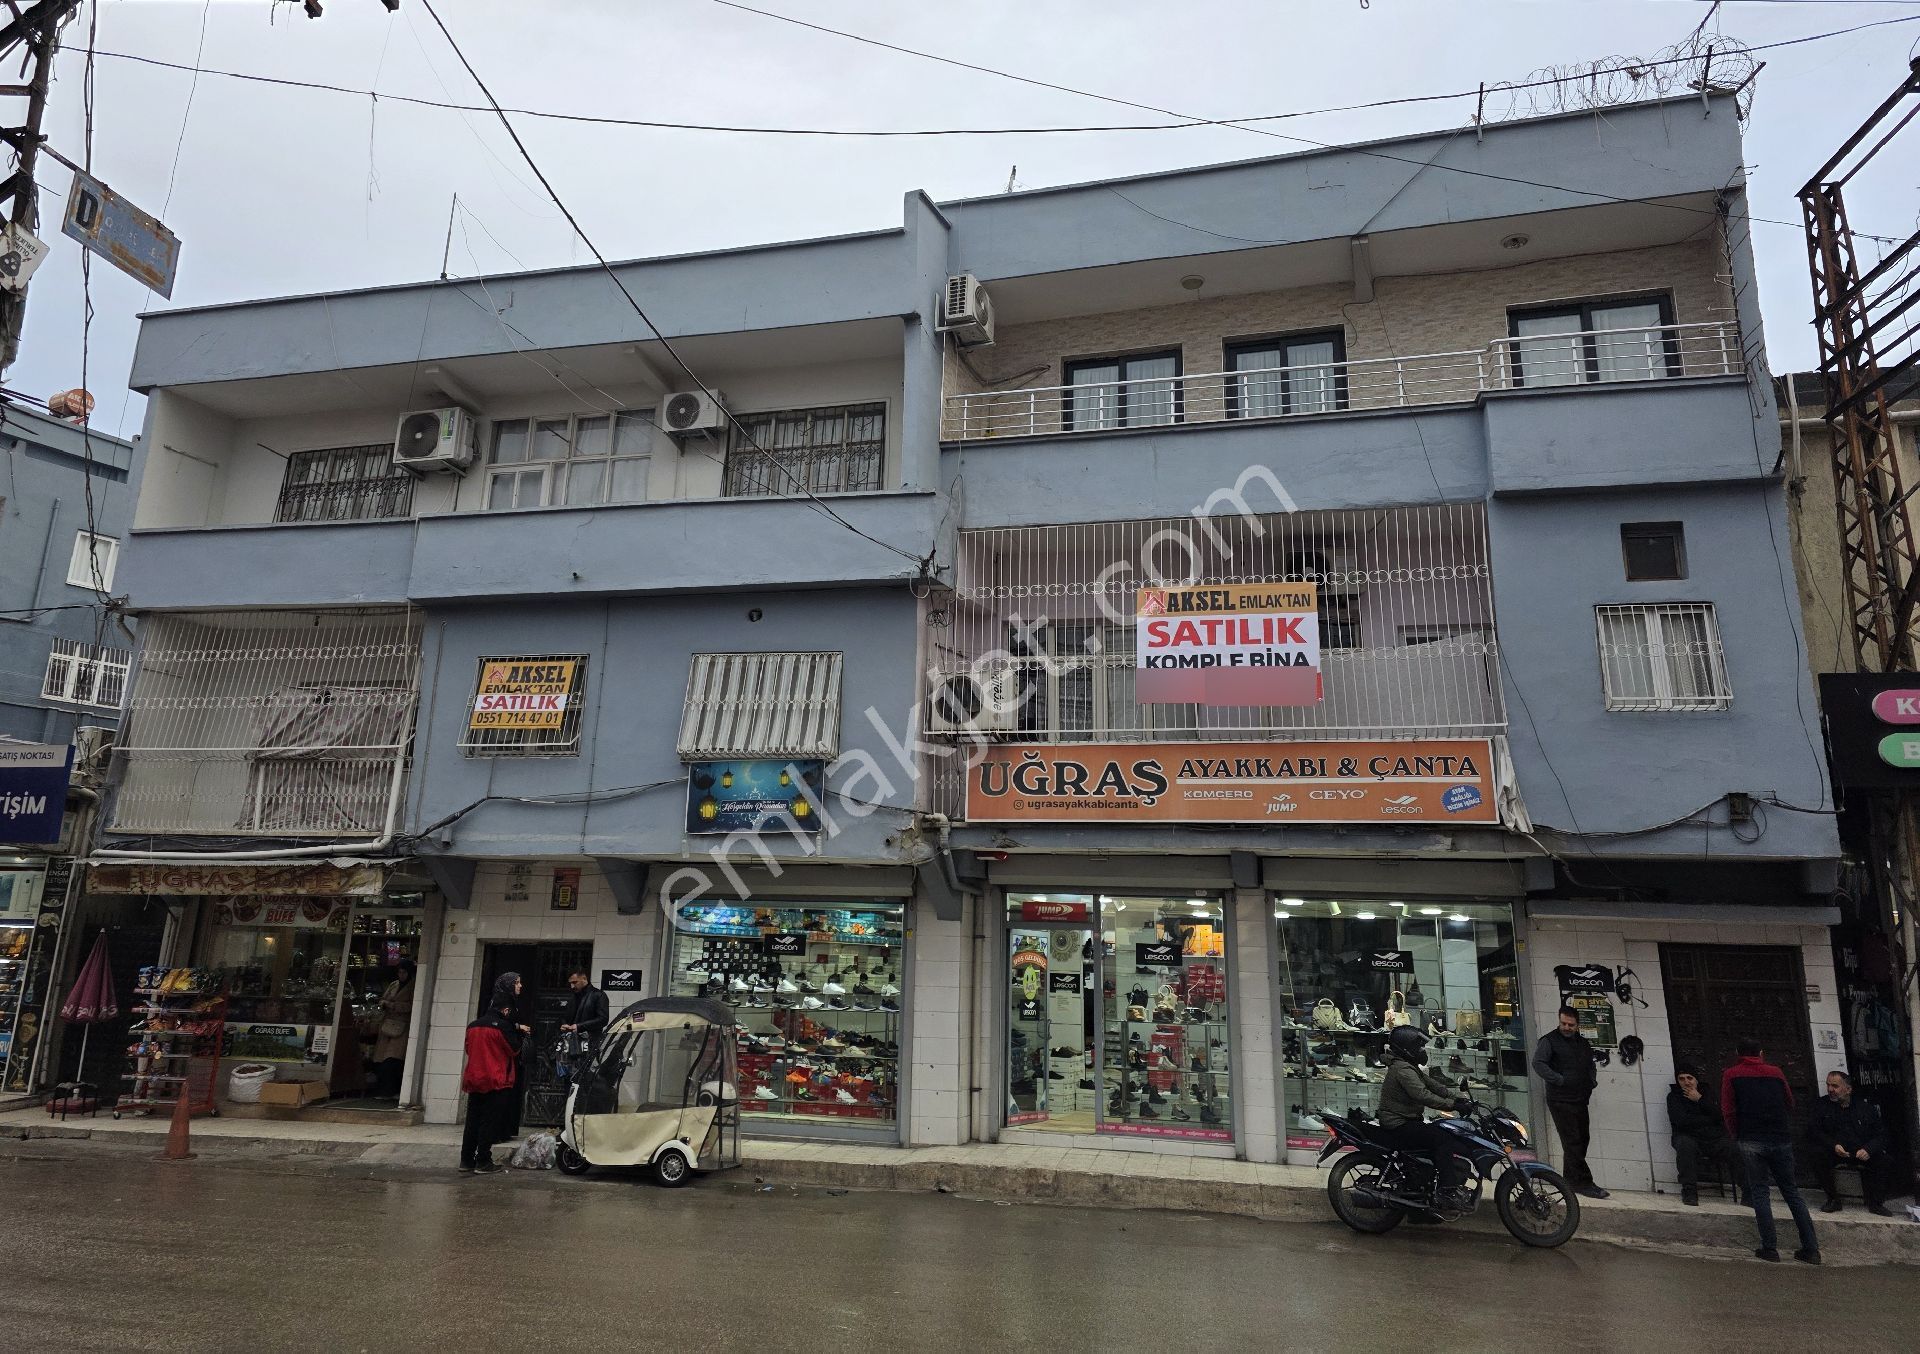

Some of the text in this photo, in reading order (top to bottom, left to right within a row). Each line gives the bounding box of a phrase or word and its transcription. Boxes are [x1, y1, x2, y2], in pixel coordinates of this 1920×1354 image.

[1166, 590, 1311, 613] AKSEL EMLAK'TAN
[1147, 617, 1308, 648] SATILIK
[506, 665, 567, 684] AKSEL
[484, 684, 565, 694] EMLAK'TAN
[480, 695, 561, 710] SATILIK
[476, 712, 559, 724] 0551 714 47 01
[1176, 756, 1480, 781] AYAKKABI & ÇANTA
[979, 750, 1169, 807] UĞRAŞ
[1309, 790, 1365, 800] CEYO
[1027, 800, 1139, 810] ugrasayakkabicanta
[1266, 803, 1298, 815] JUMP
